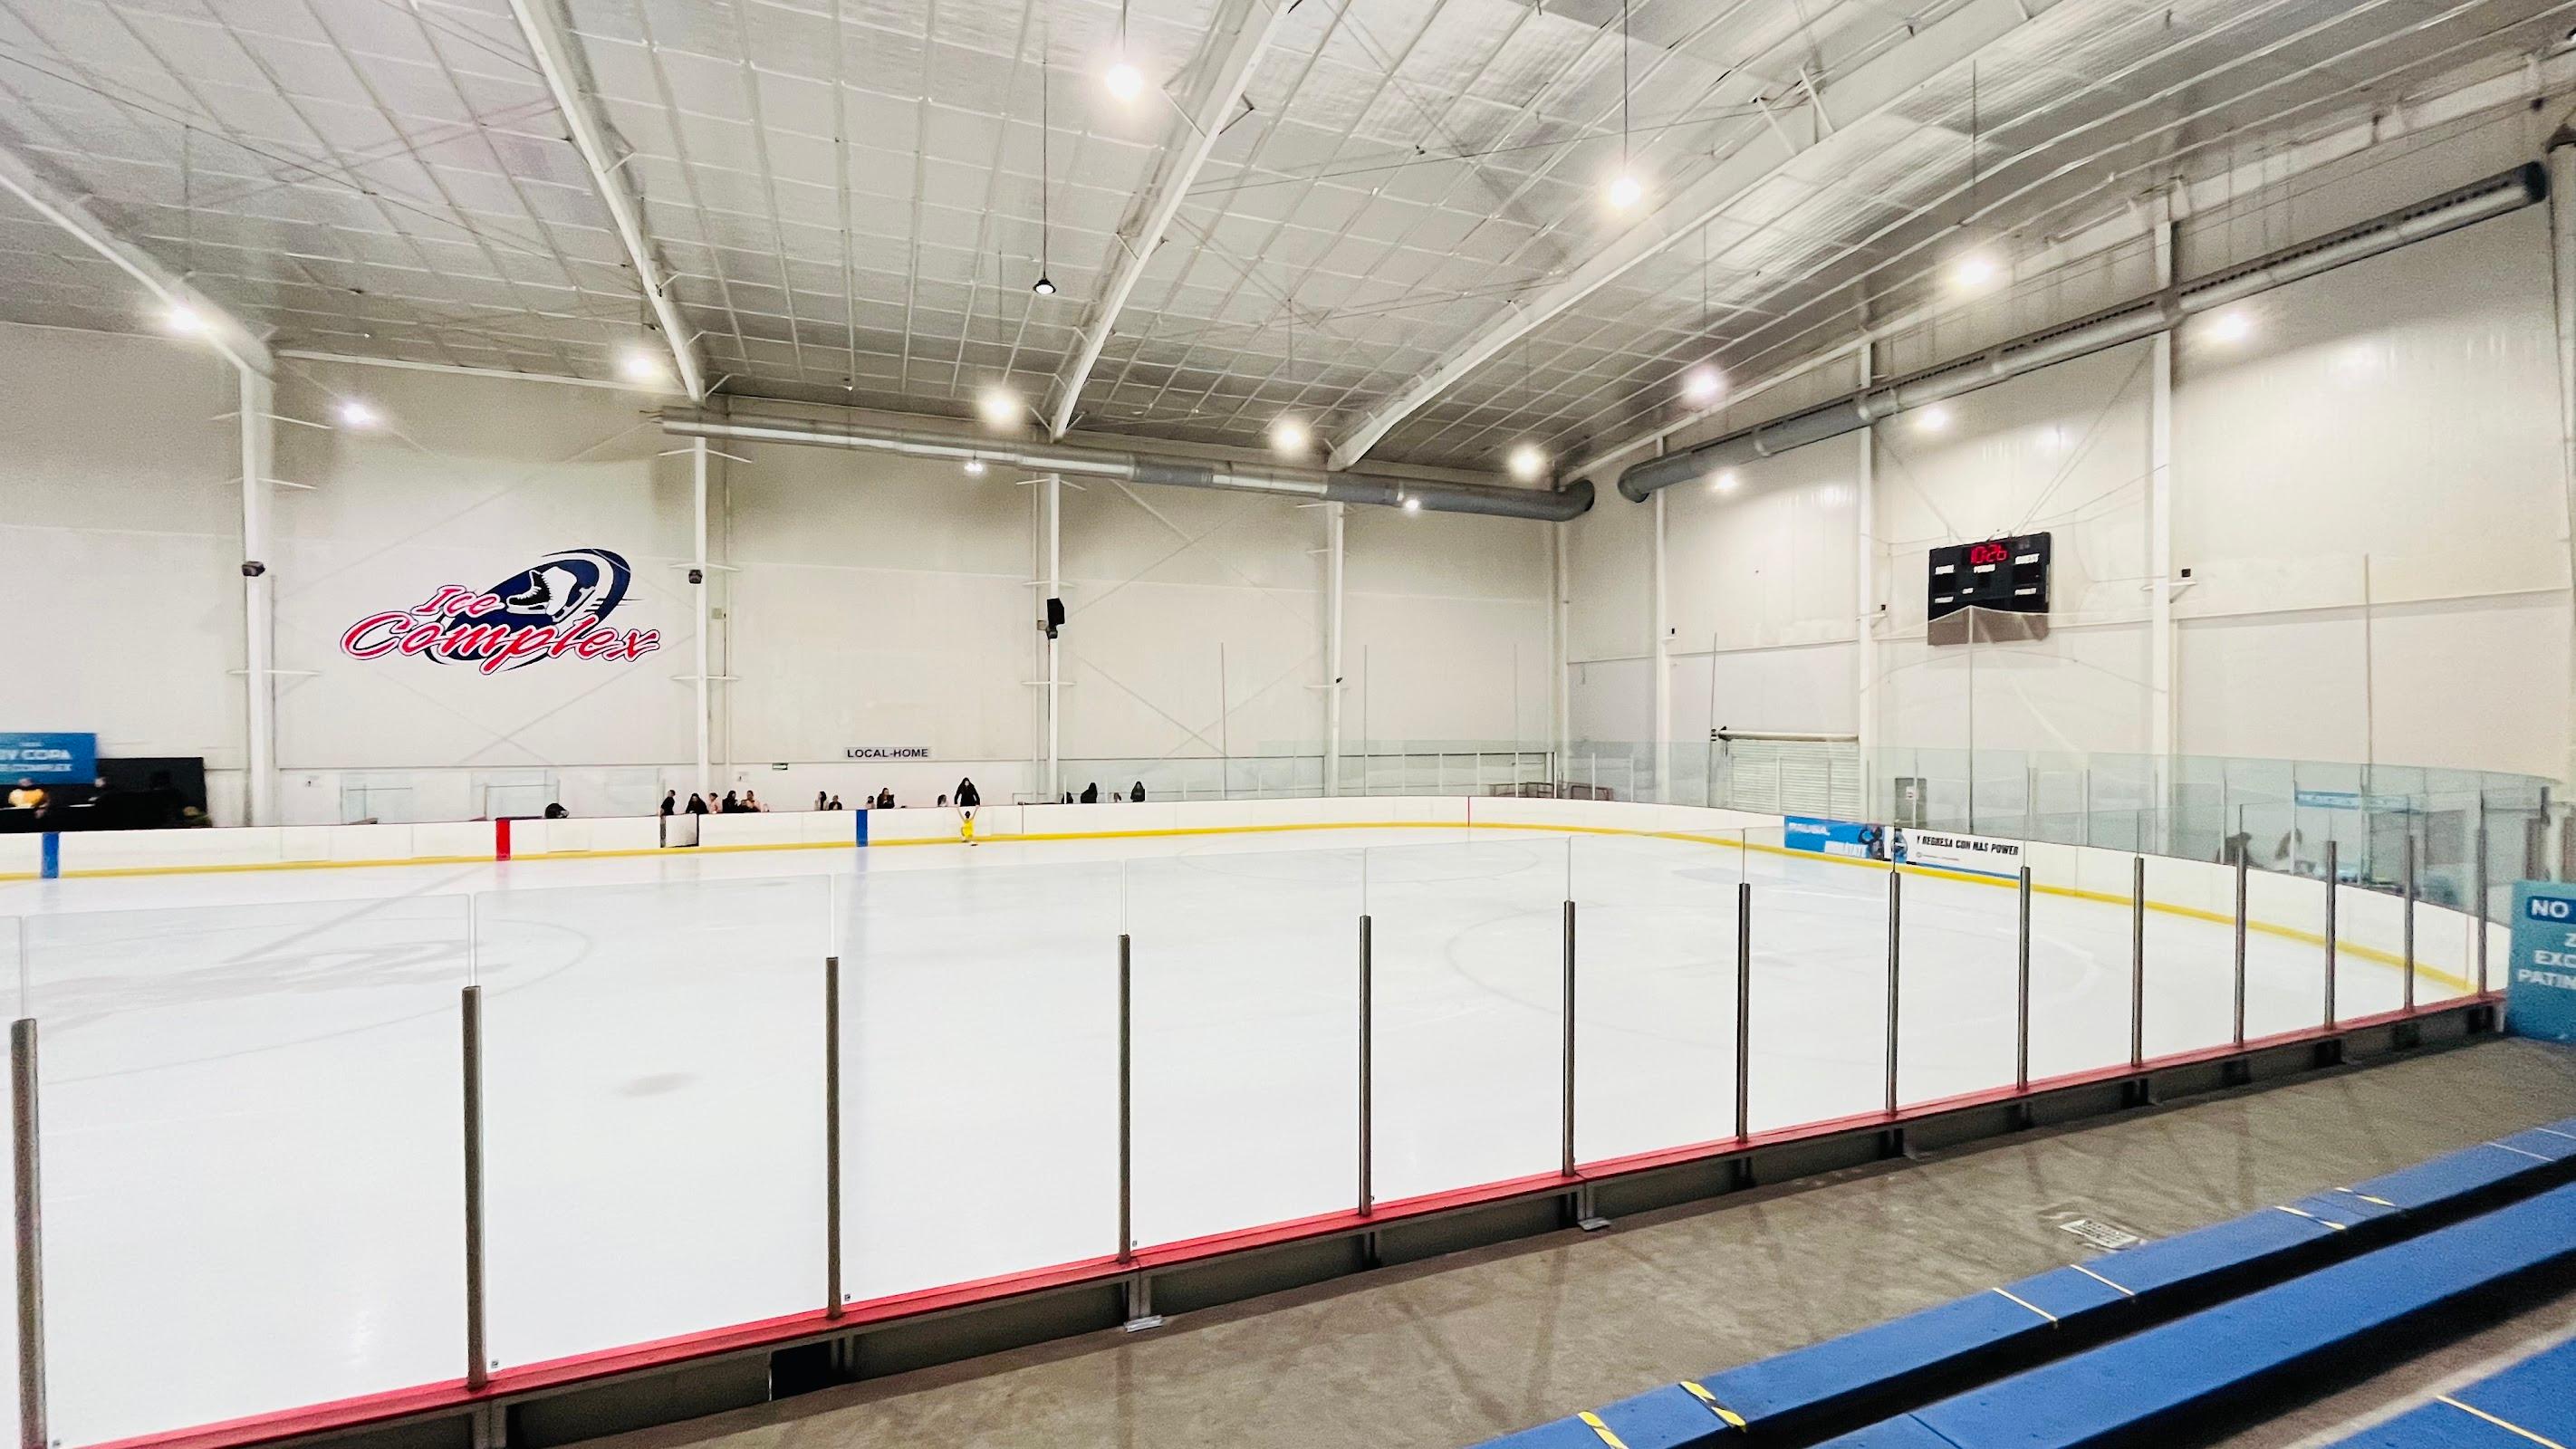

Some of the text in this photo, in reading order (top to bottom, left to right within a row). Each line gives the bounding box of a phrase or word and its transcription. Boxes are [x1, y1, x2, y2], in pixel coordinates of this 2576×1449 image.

[410, 584, 505, 618] Ice
[341, 611, 661, 676] Complex
[847, 748, 928, 758] LOCAL-HOME
[2531, 898, 2570, 918] NO
